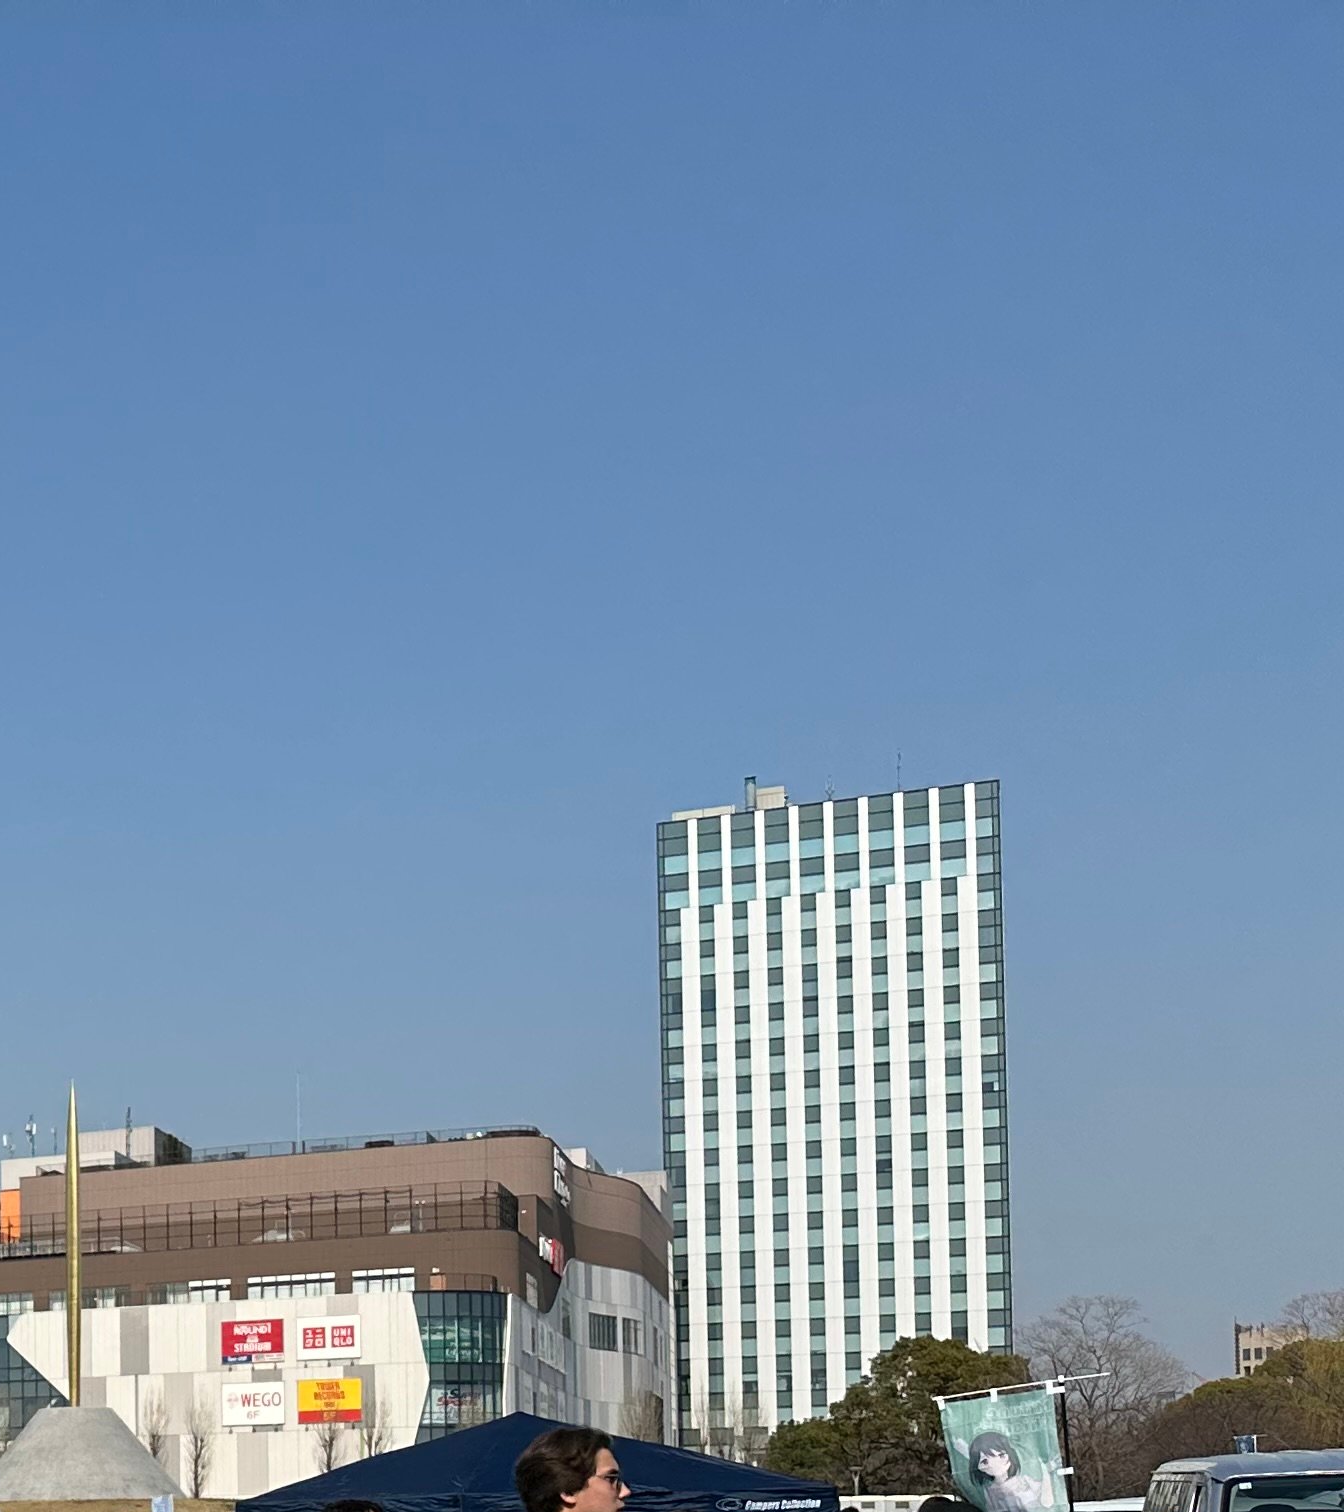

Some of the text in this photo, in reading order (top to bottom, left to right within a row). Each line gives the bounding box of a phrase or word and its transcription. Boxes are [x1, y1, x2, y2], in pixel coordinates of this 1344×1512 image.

[333, 1327, 351, 1337] UNI
[241, 1392, 282, 1407] WEGO
[744, 1499, 822, 1511] Campers Collection
